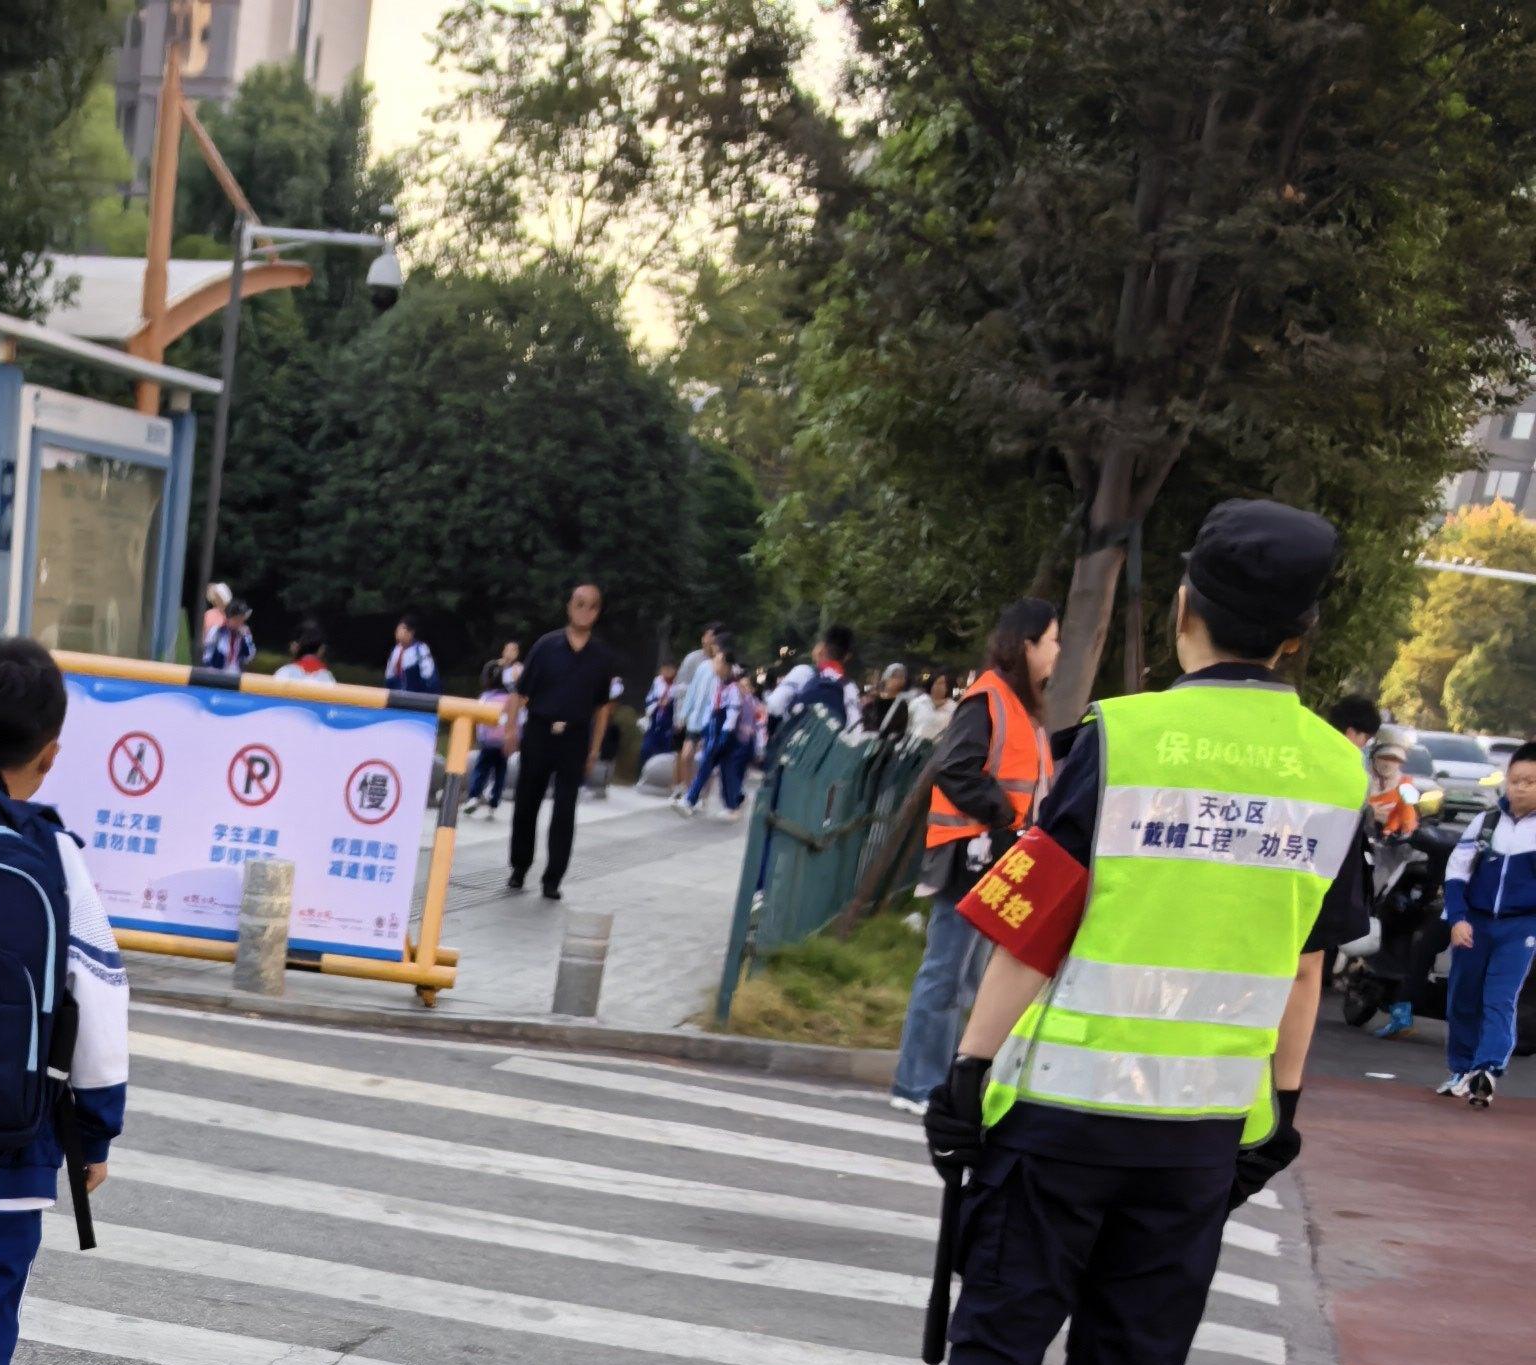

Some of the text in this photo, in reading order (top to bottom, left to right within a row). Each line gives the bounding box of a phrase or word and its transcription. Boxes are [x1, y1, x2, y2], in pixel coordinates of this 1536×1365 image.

[357, 772, 388, 812] 慢
[1197, 795, 1268, 825] 天心区
[971, 872, 1035, 929] 联控
